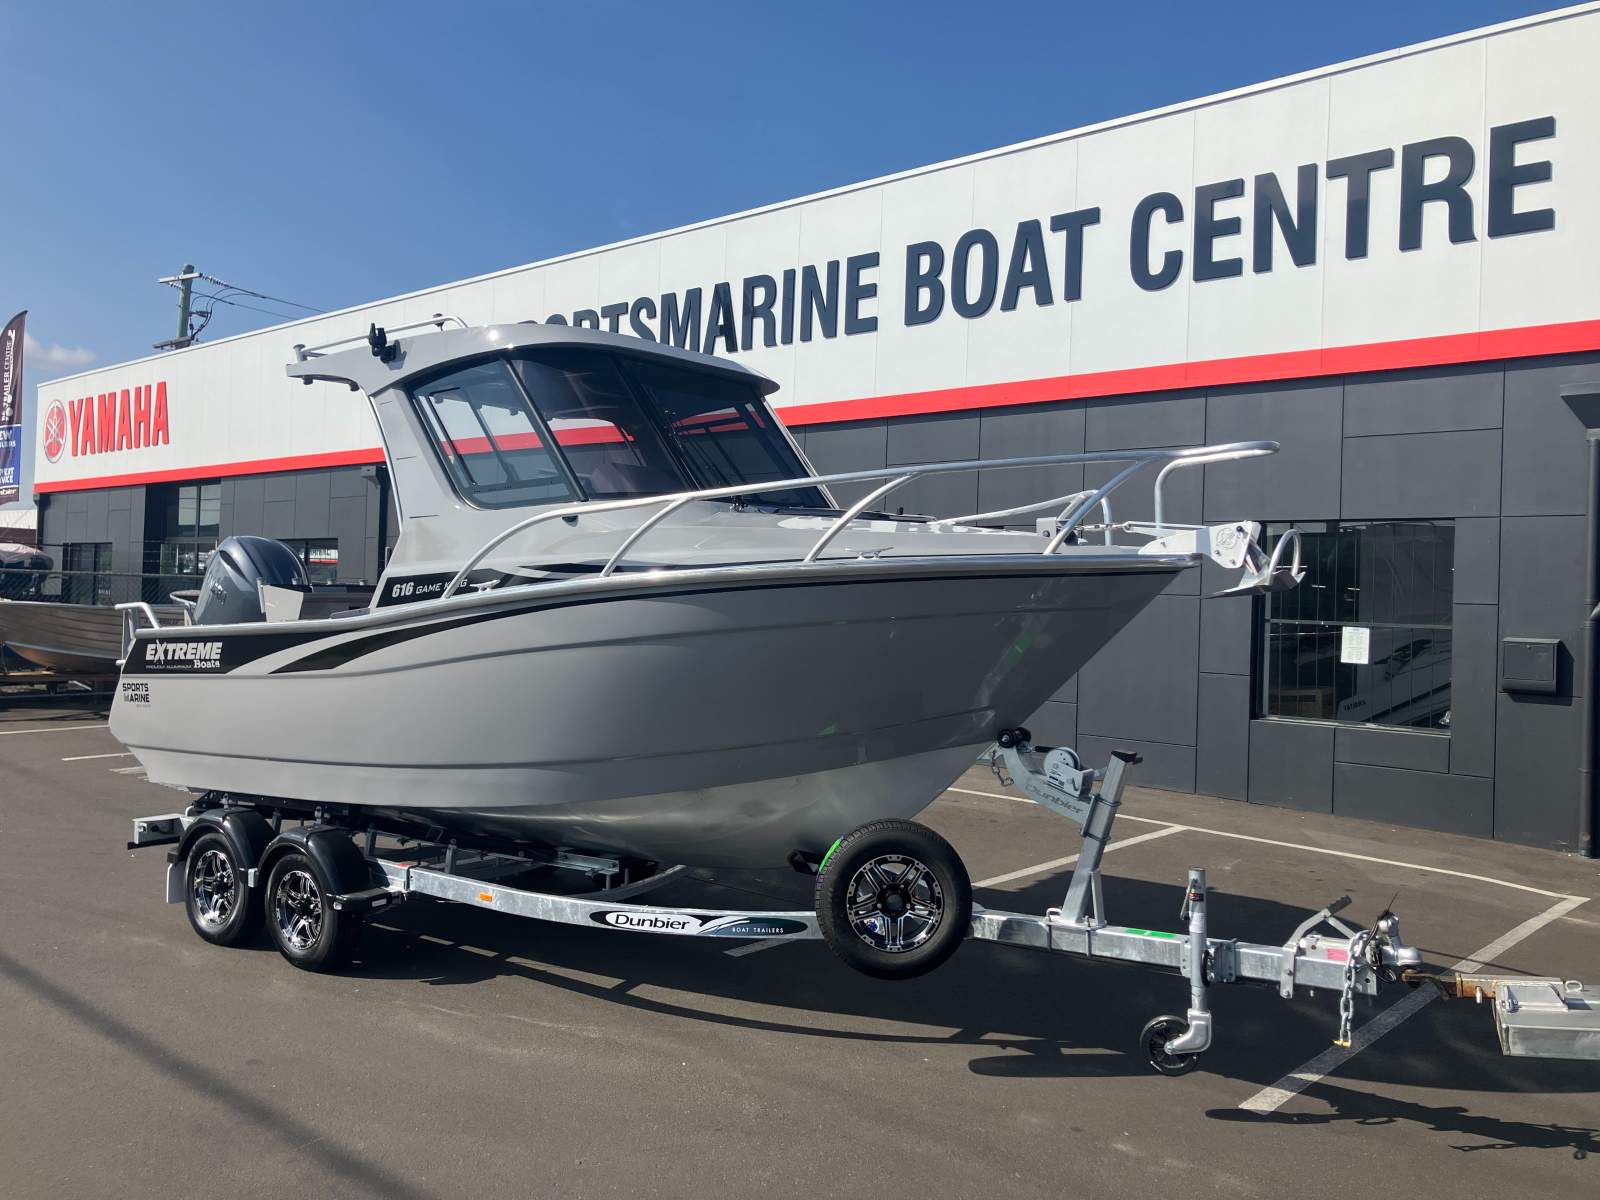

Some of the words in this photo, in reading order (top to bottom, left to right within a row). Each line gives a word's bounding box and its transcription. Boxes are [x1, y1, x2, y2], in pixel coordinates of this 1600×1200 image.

[903, 205, 1101, 328] BOAT
[1129, 115, 1557, 294] CENTRE
[68, 381, 170, 457] YAMAHA
[0, 430, 12, 440] EW
[391, 582, 415, 598] 616
[415, 582, 442, 594] GAME
[444, 579, 468, 590] KG
[145, 640, 223, 663] EXTREME
[122, 682, 149, 692] SPORTS
[615, 914, 690, 930] Dunbier
